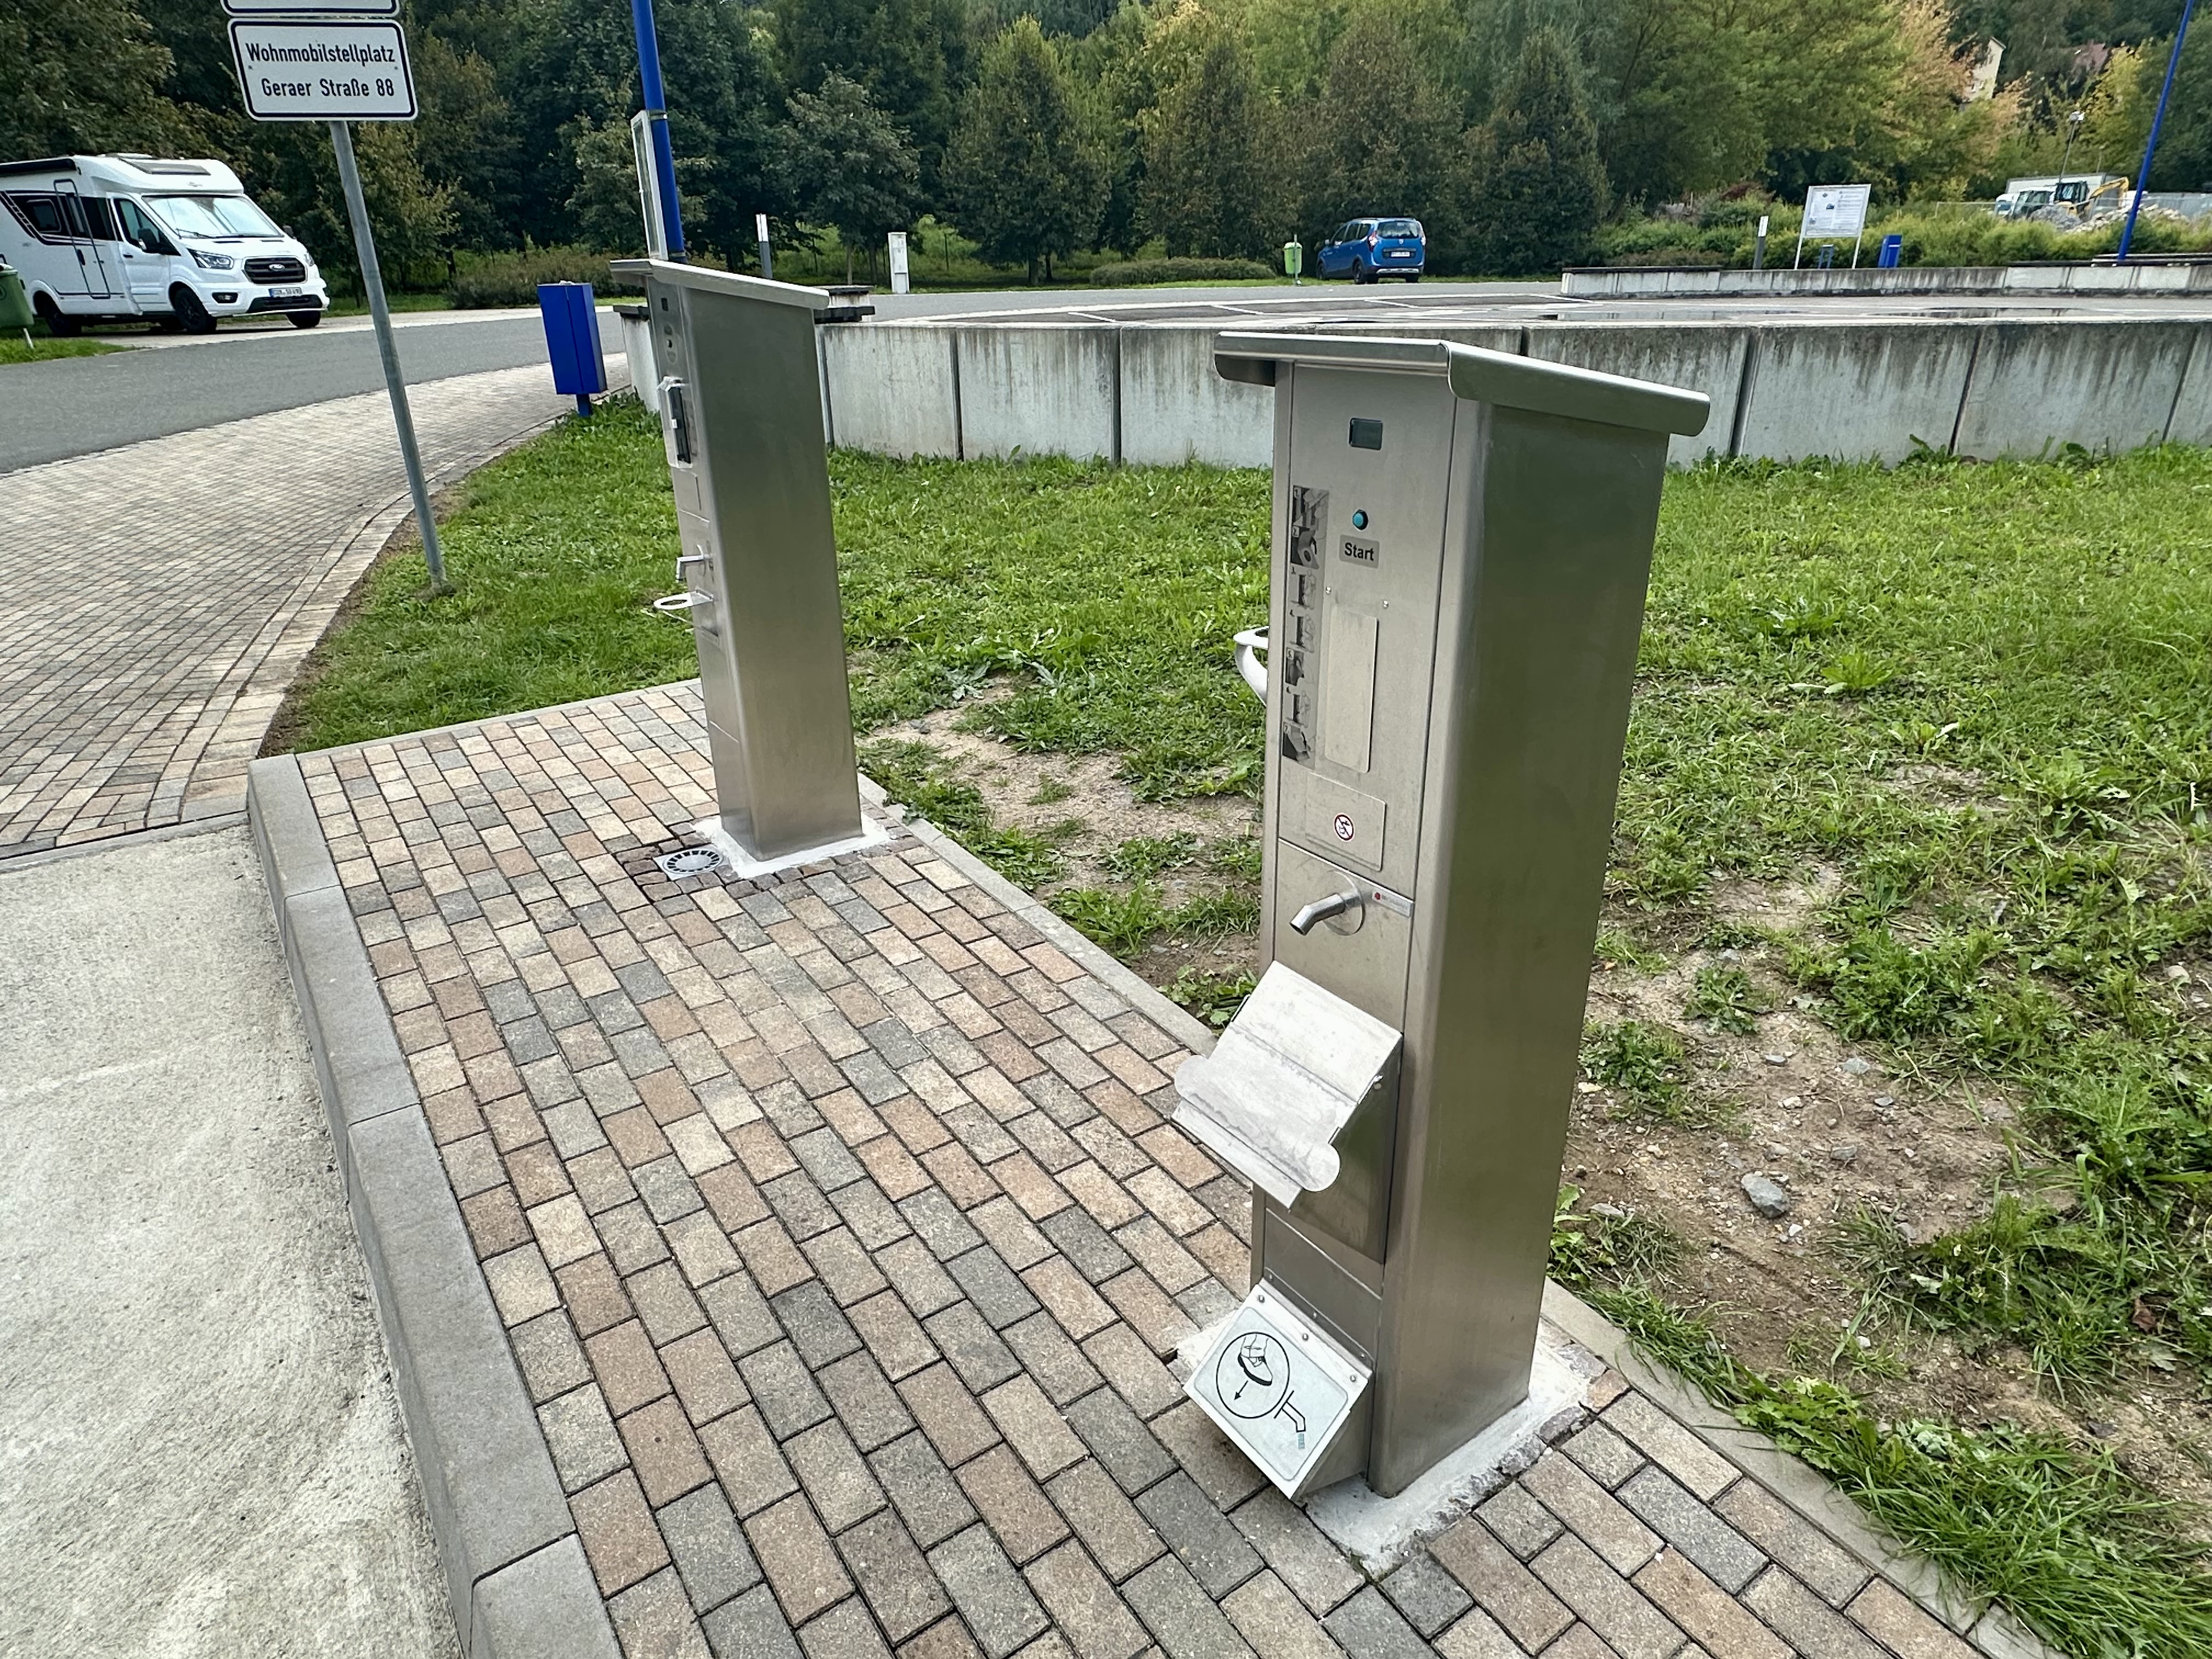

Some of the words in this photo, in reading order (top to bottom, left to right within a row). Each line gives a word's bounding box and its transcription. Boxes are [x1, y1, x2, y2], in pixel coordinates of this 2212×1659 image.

[245, 43, 396, 66] Wohnmobilstellplatz
[261, 78, 312, 96] Geraer
[319, 78, 370, 97] Straße
[375, 79, 394, 97] 88
[1344, 542, 1374, 561] Start
